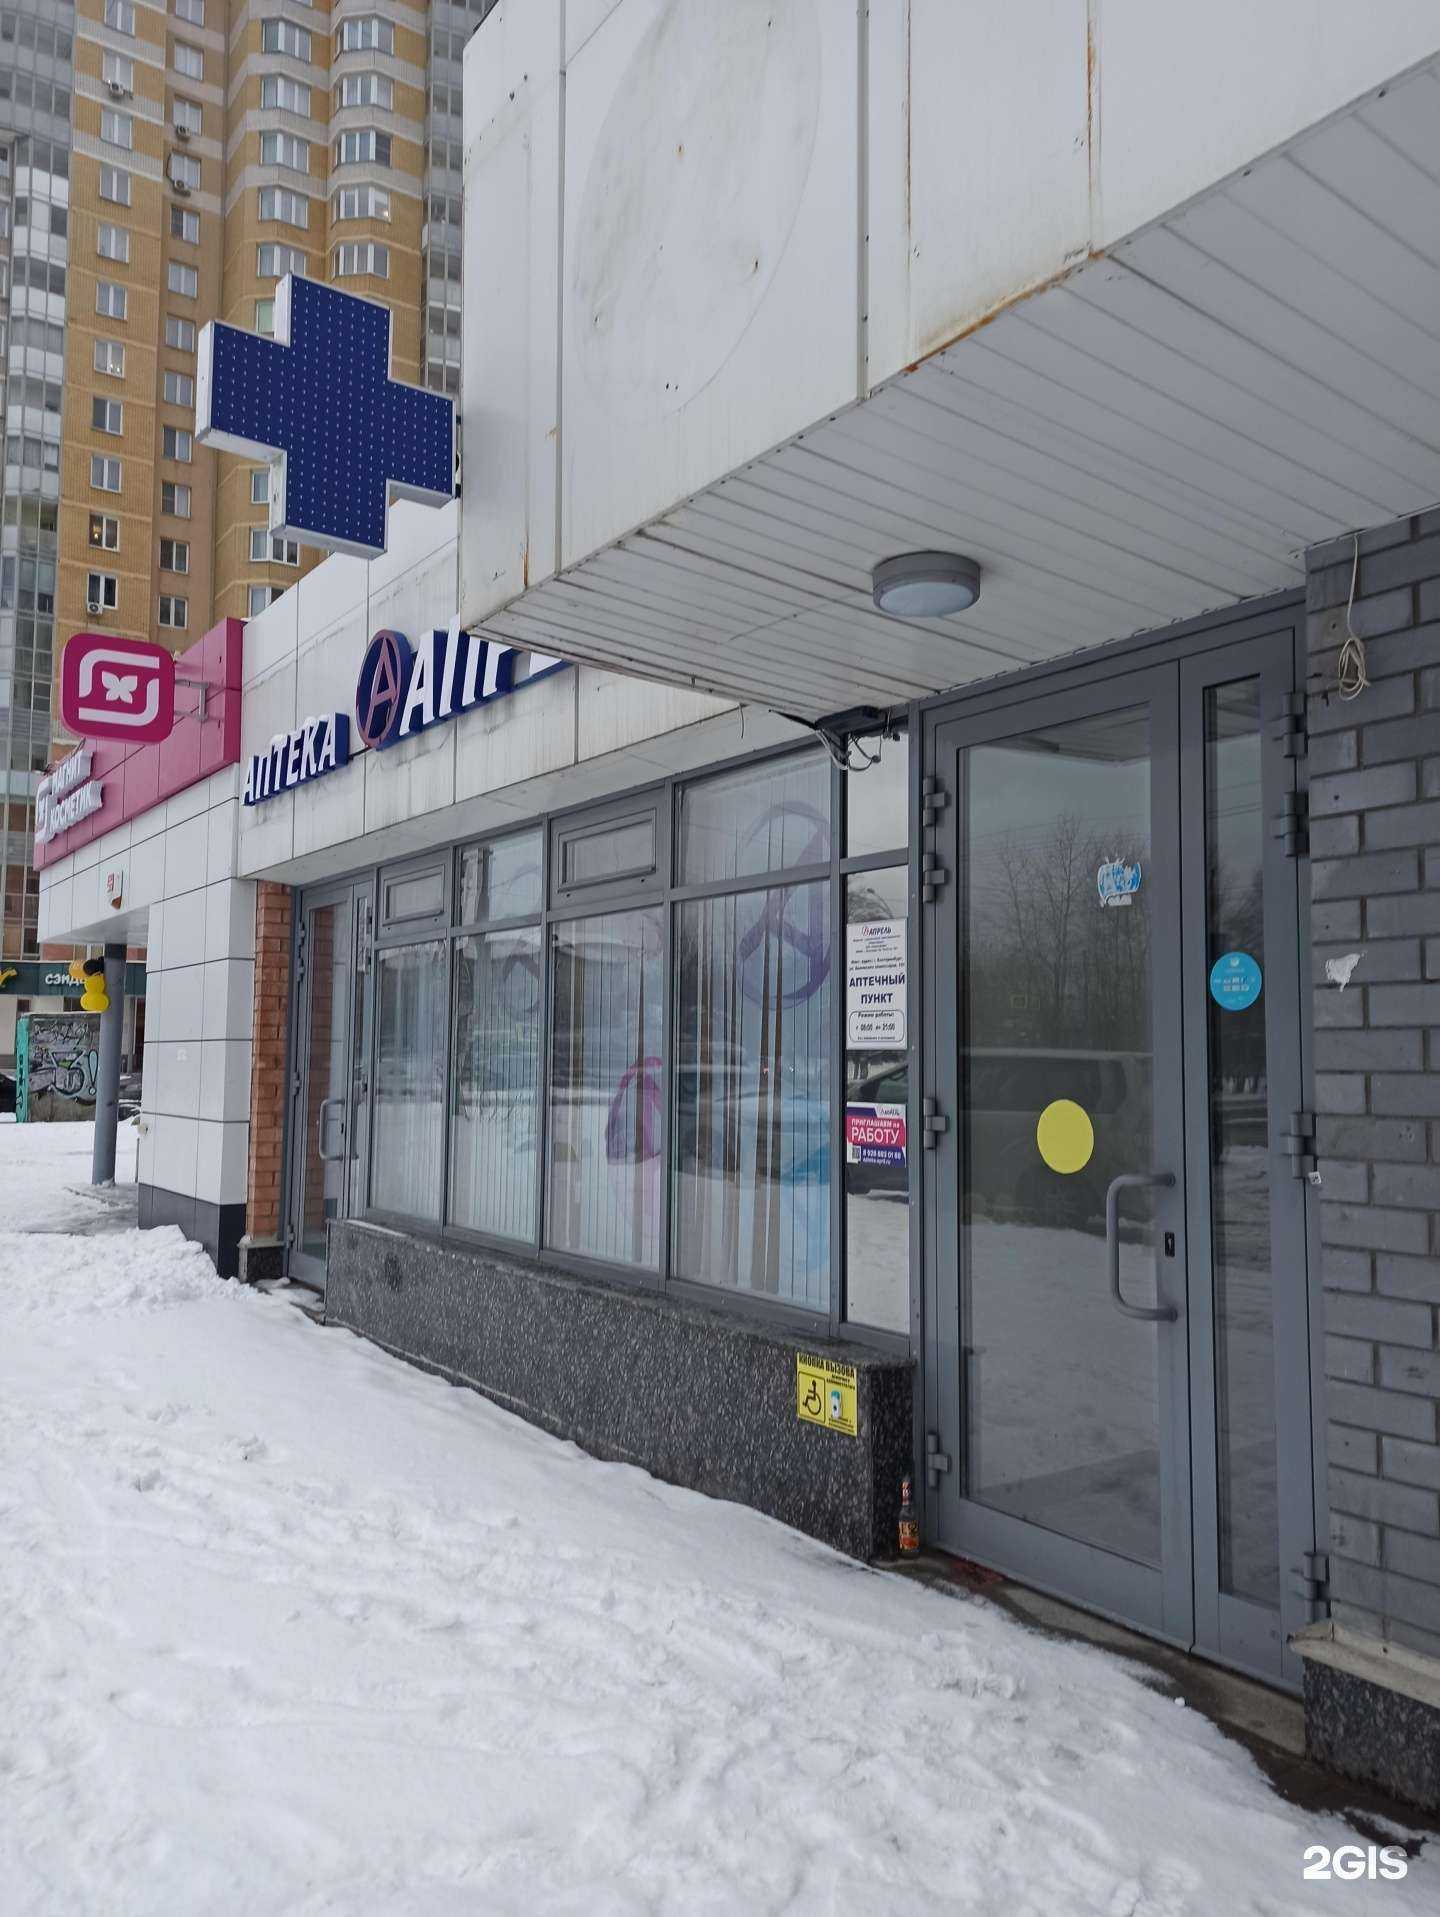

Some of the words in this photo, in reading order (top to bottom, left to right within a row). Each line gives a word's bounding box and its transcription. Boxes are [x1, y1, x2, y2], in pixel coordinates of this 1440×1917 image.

[243, 712, 337, 805] АПТЕКА
[849, 973, 905, 988] АПТЕЧНЫЙ
[860, 992, 893, 1005] ПУНКТ
[851, 1118, 892, 1128] ПРИГЛАШАЕМ
[851, 1126, 900, 1145] РАБОТУ
